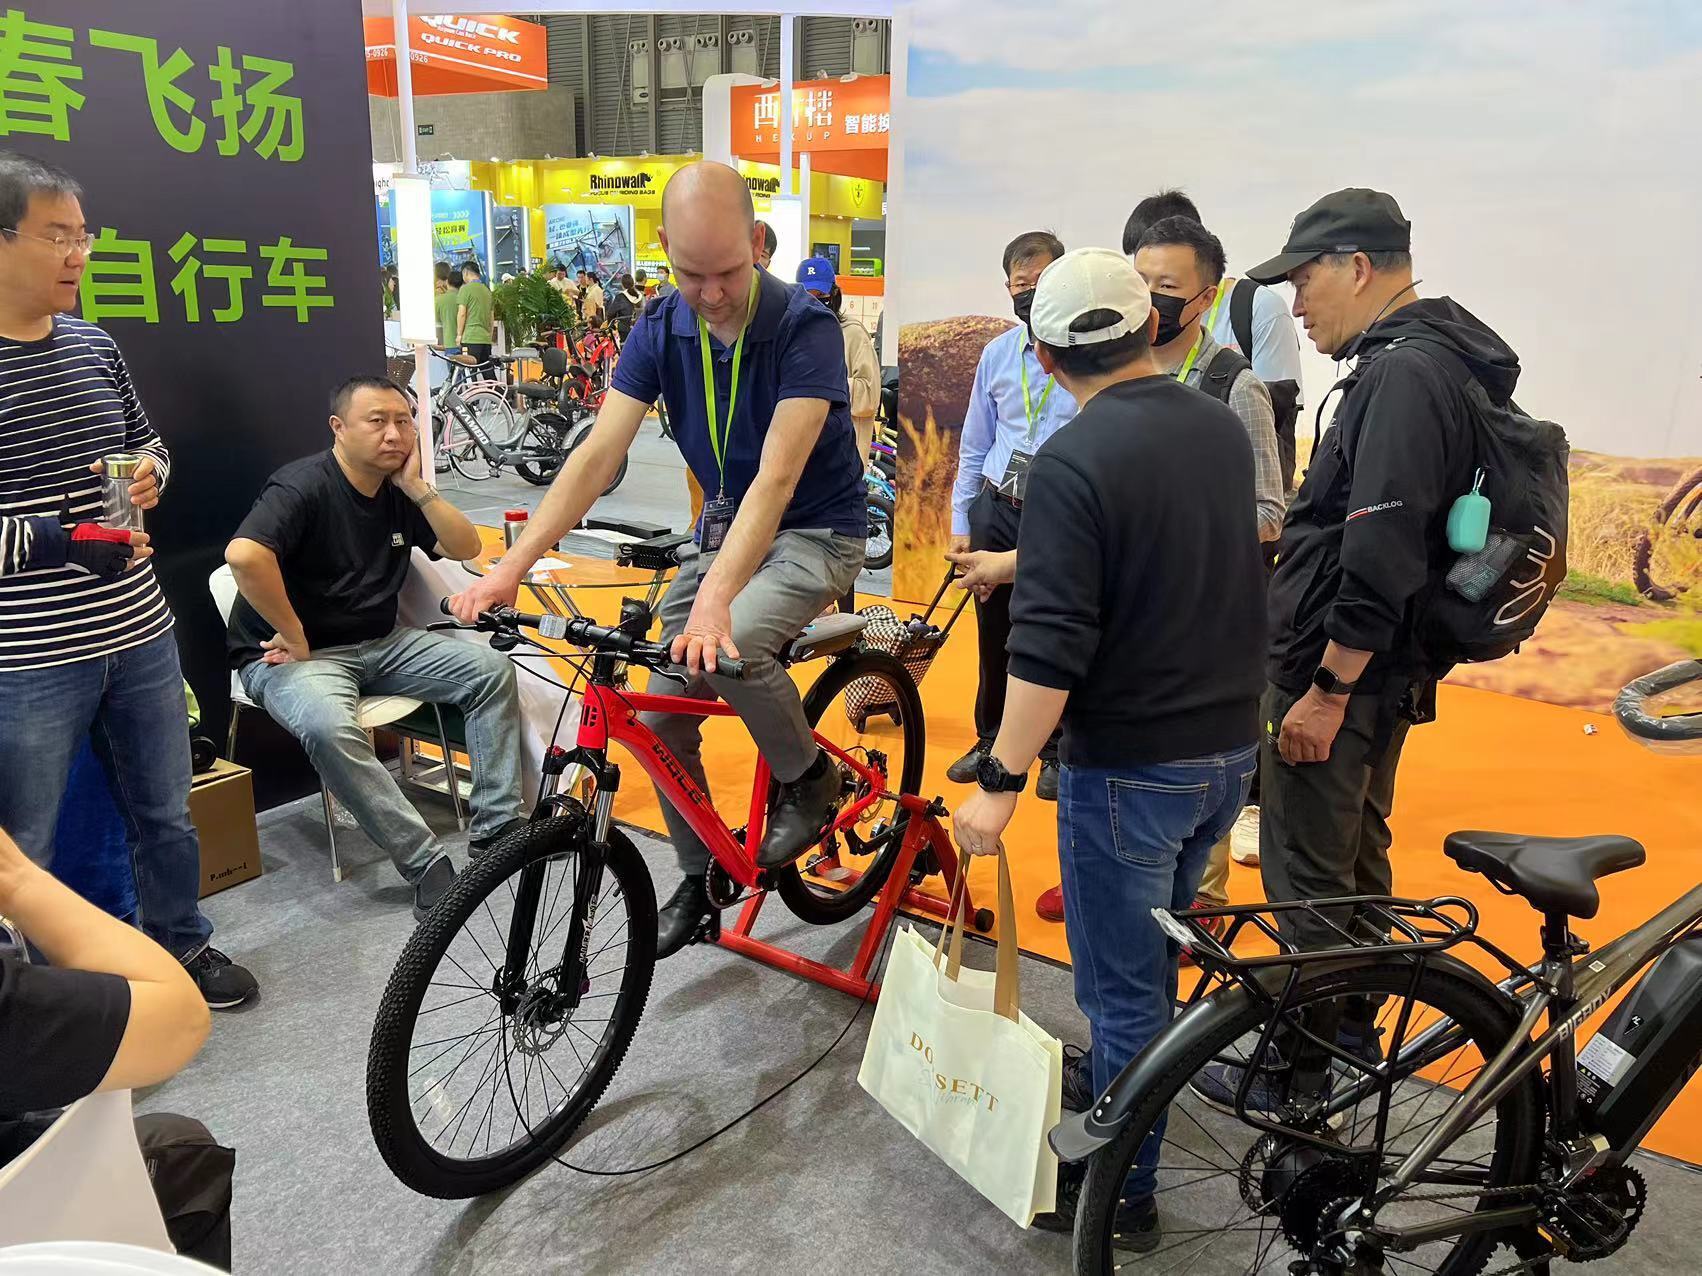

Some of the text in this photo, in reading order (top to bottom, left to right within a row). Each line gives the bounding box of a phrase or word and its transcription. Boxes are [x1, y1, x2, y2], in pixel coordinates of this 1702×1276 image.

[0, 9, 305, 162] 春飞扬
[421, 33, 521, 62] QUICK PRO
[78, 227, 335, 323] 自行车
[1367, 500, 1403, 513] BACKLOG
[911, 1031, 999, 1112] DOSETT
